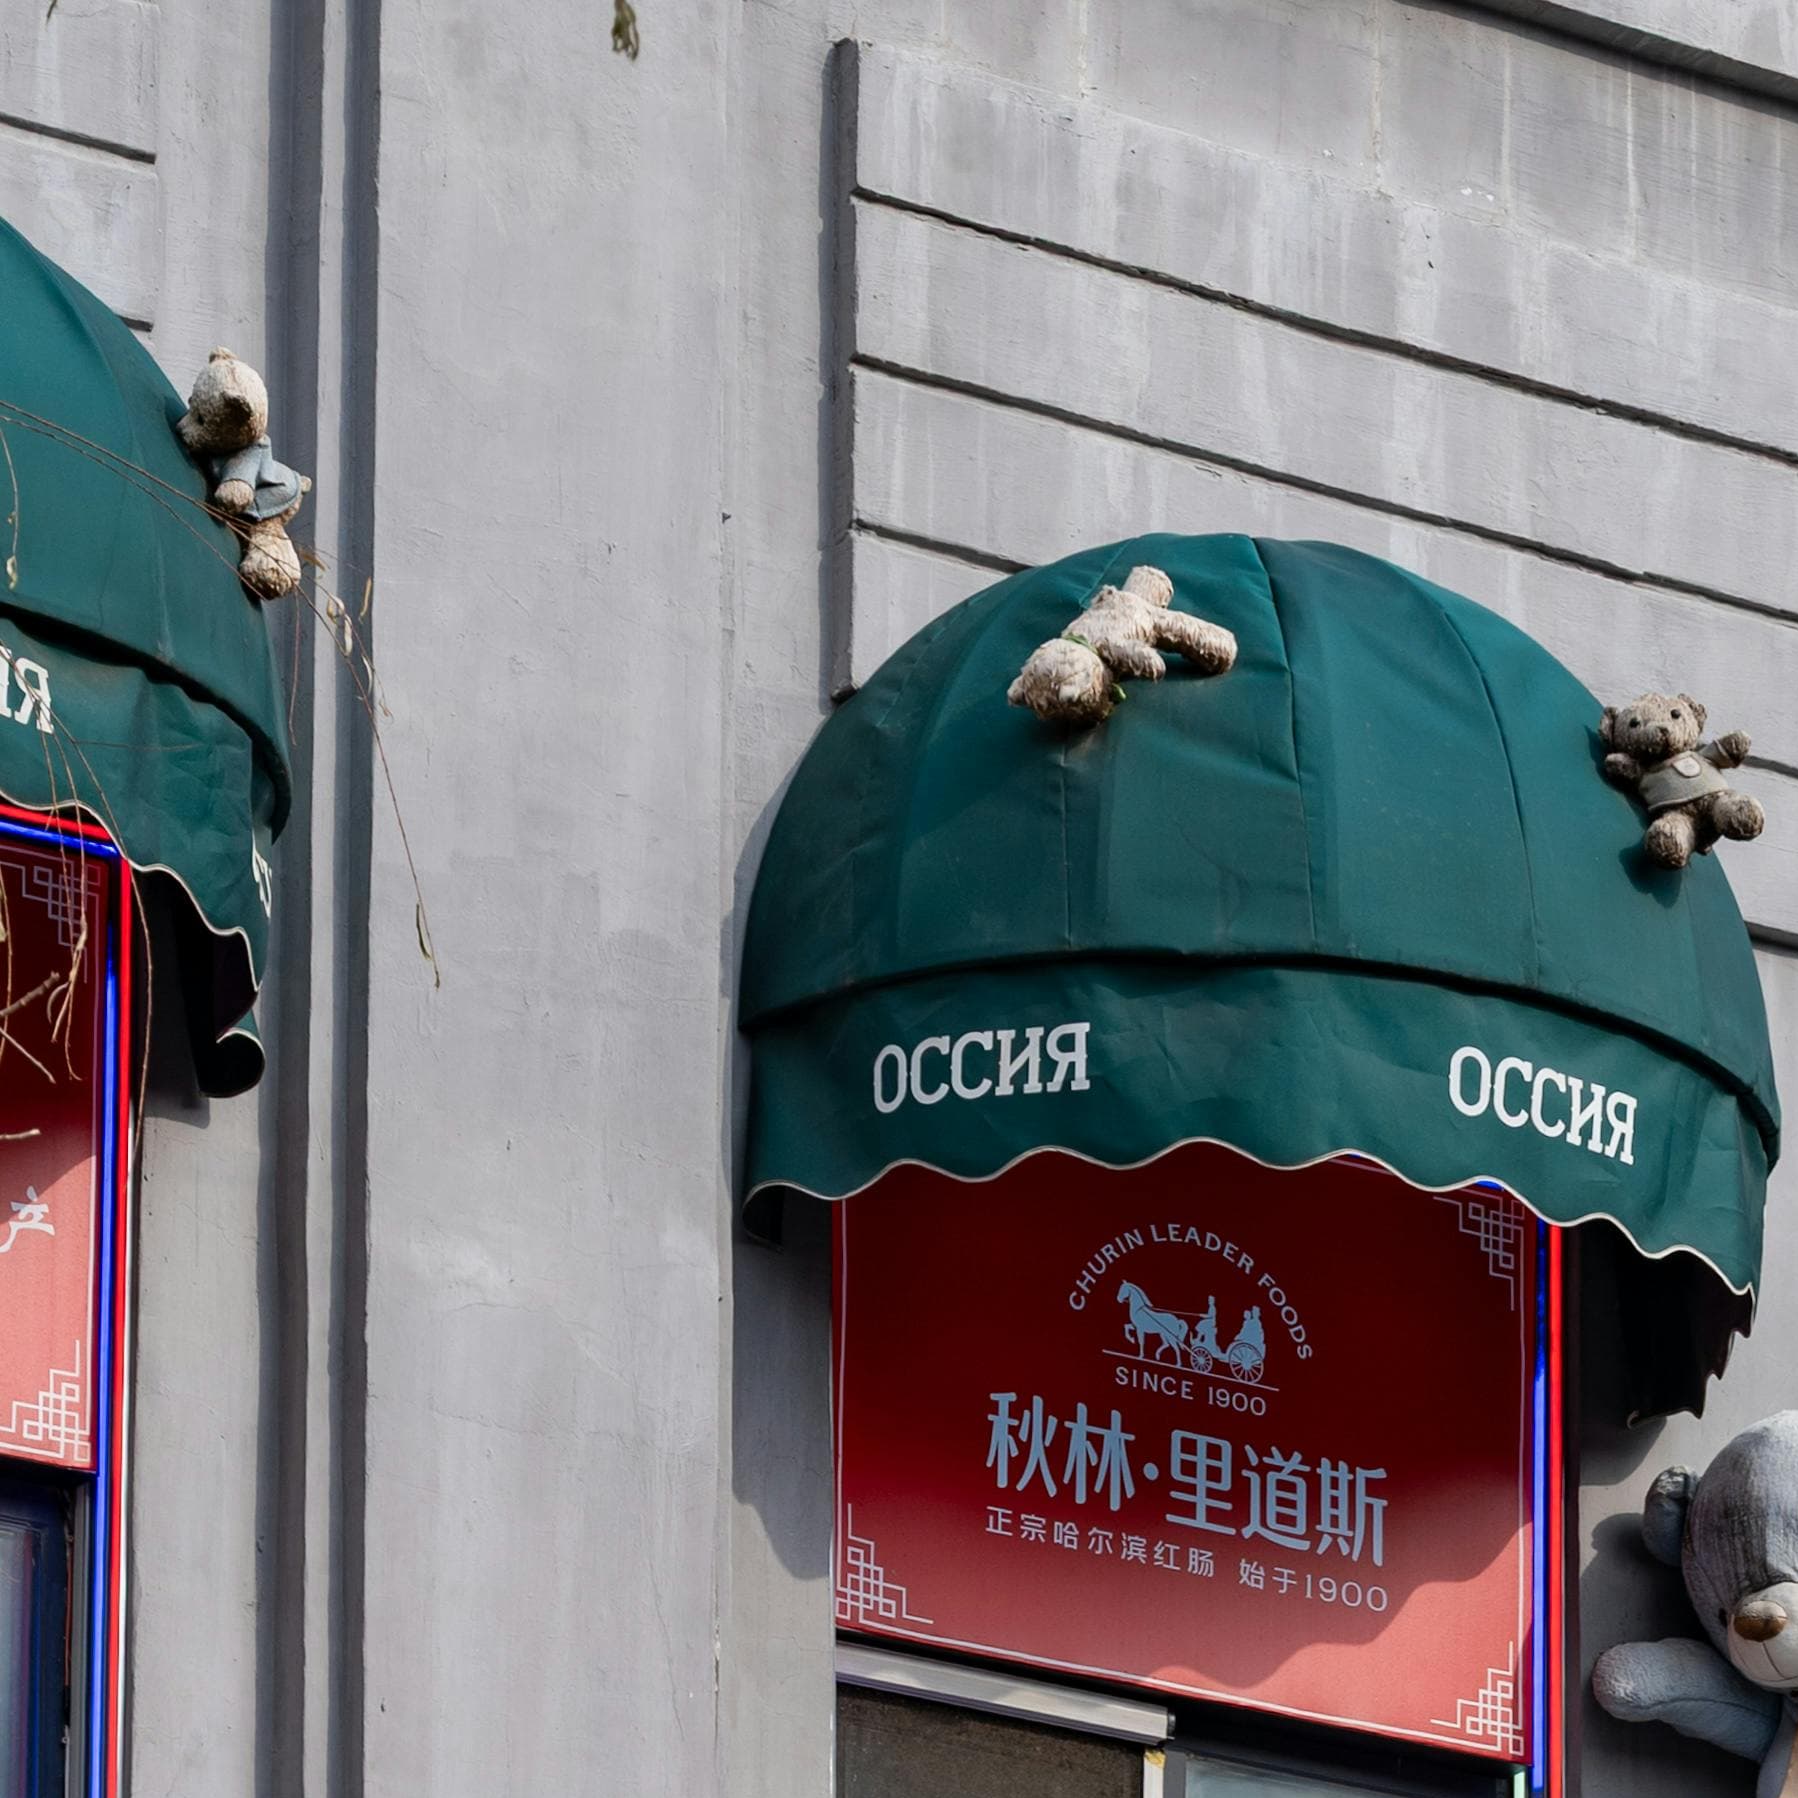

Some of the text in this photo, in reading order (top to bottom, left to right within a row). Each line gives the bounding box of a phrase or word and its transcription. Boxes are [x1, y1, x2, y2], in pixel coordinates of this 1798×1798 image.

[872, 1021, 1091, 1115] ОССИЯ
[1447, 1046, 1638, 1166] ОССИЯ
[1068, 1223, 1313, 1360] CHURIN LEADER FOODS
[1114, 1366, 1267, 1416] SINCE 1900
[985, 1391, 1389, 1567] 秋林·里道斯
[984, 1505, 1389, 1612] 正宗哈尔滨红肠 始于1900
